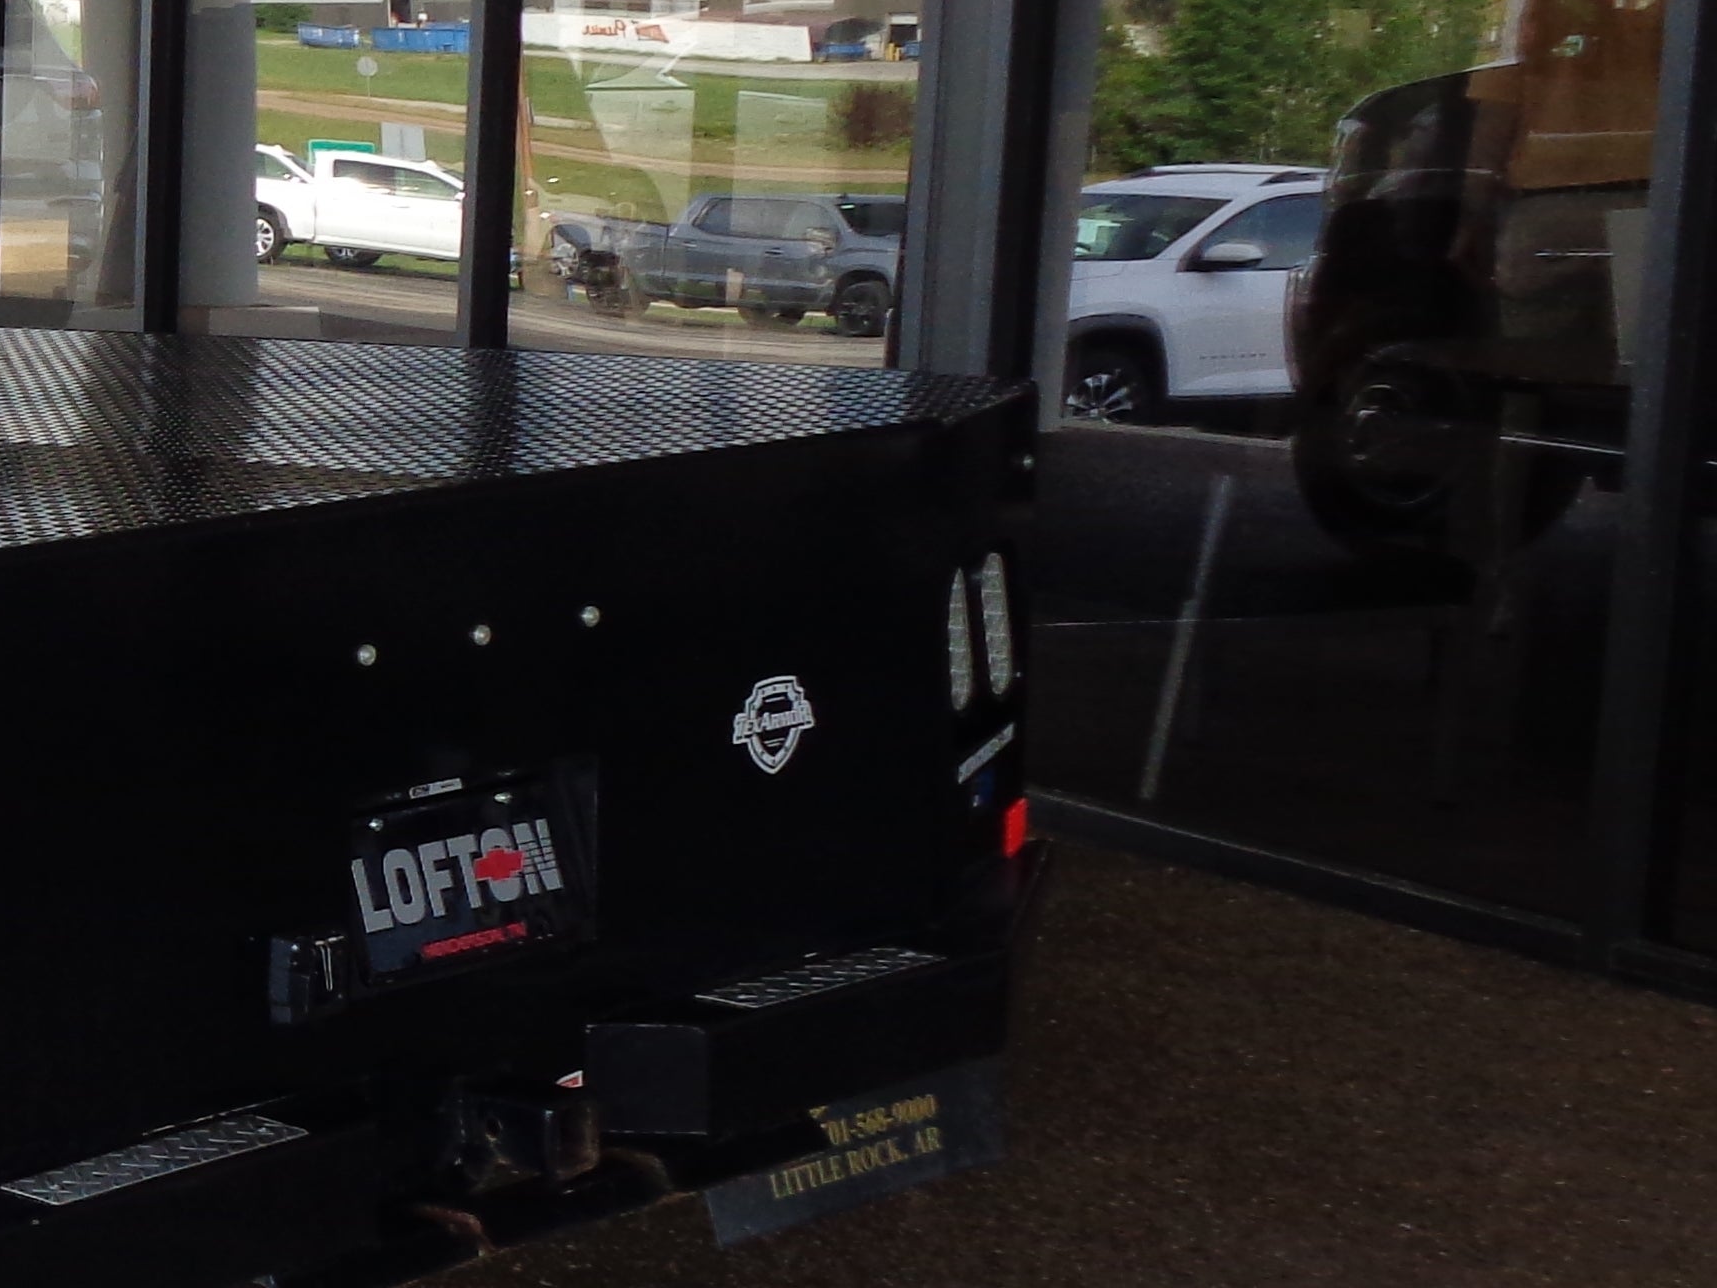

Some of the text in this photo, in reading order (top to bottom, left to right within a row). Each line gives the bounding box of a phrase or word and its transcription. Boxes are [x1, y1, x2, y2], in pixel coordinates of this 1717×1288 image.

[351, 818, 563, 933] LOFTON
[769, 1155, 846, 1200] LITTLE
[915, 1126, 943, 1154] AR
